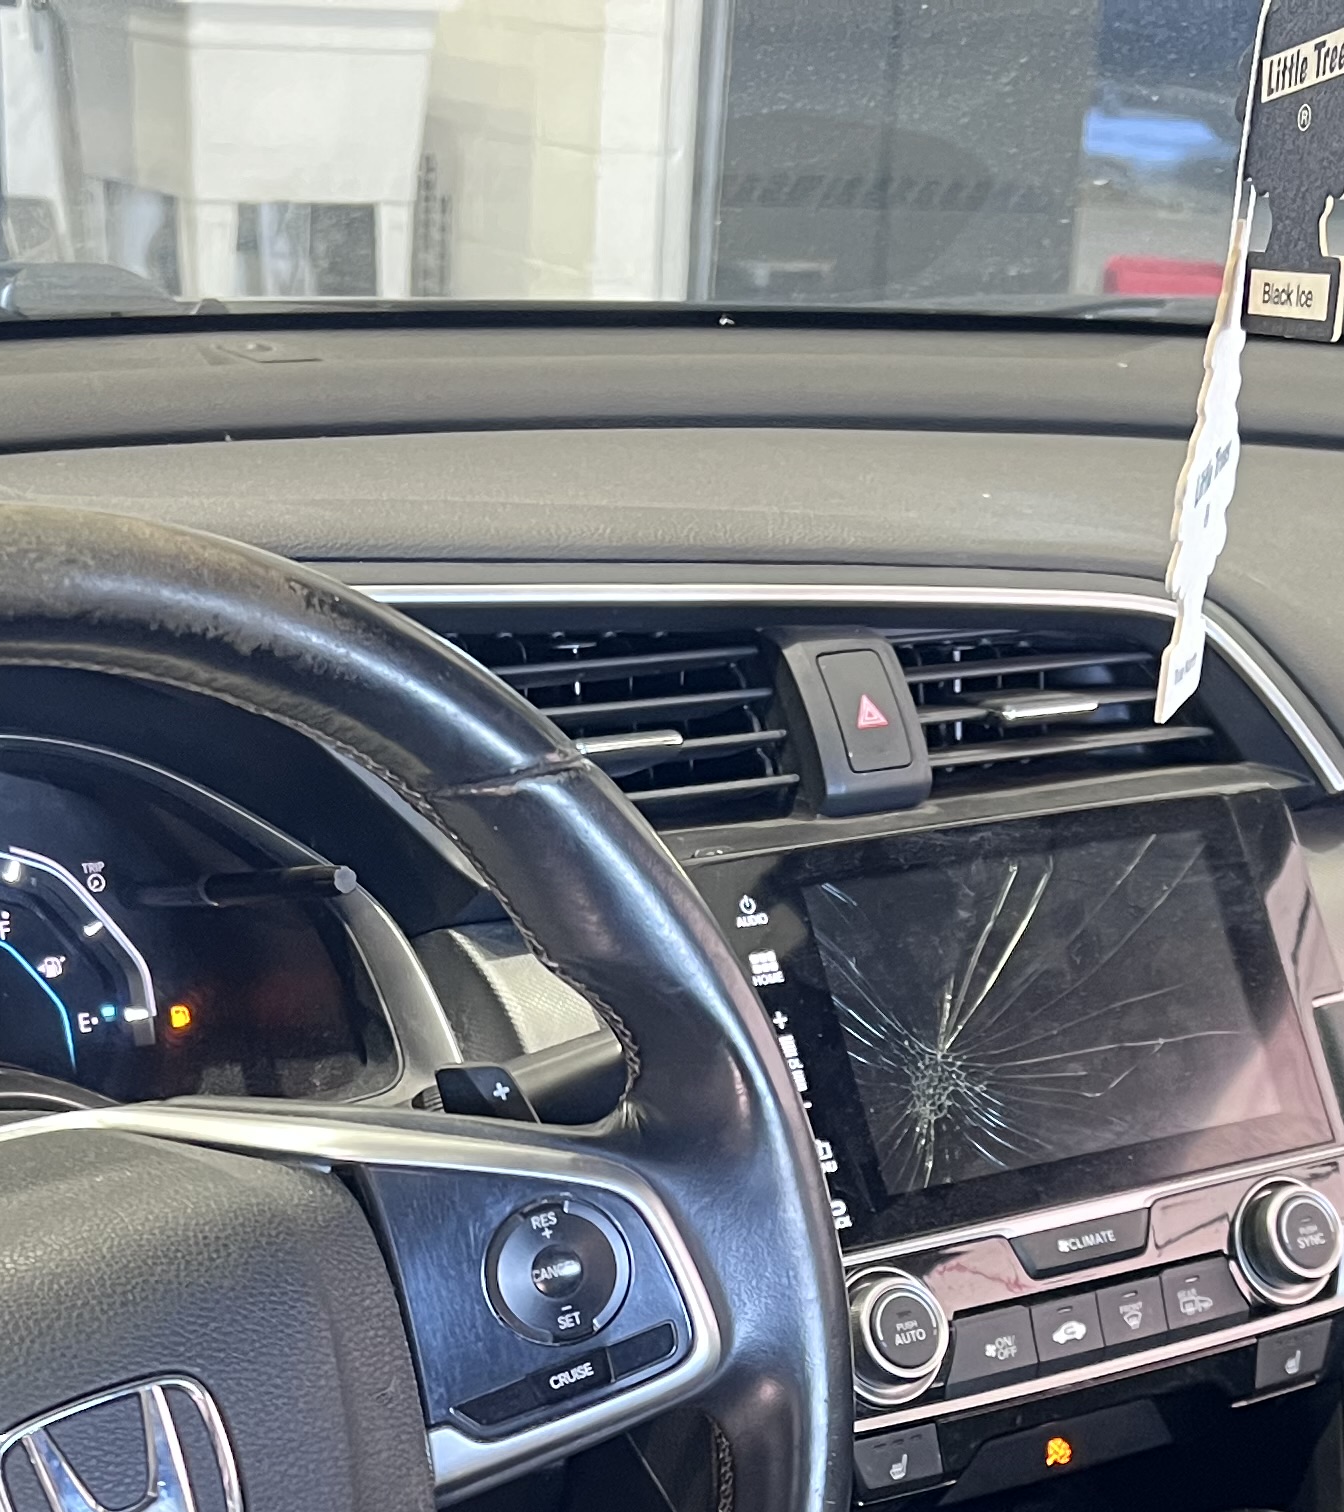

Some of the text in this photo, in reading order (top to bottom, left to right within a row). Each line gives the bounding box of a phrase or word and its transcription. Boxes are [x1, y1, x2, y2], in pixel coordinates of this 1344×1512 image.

[1266, 48, 1308, 98] Little
[1262, 281, 1313, 308] Black Ice
[80, 860, 106, 875] TRIP
[76, 1011, 93, 1034] E
[530, 1211, 558, 1231] RES
[1068, 1228, 1117, 1252] CLIMATE
[1296, 1232, 1326, 1250] SYNC
[557, 1311, 582, 1331] SET
[895, 1318, 918, 1332] PUSH
[894, 1328, 927, 1347] AUTO
[994, 1334, 1016, 1350] ON/
[996, 1345, 1018, 1361] OFF
[548, 1361, 595, 1391] CRUISE
